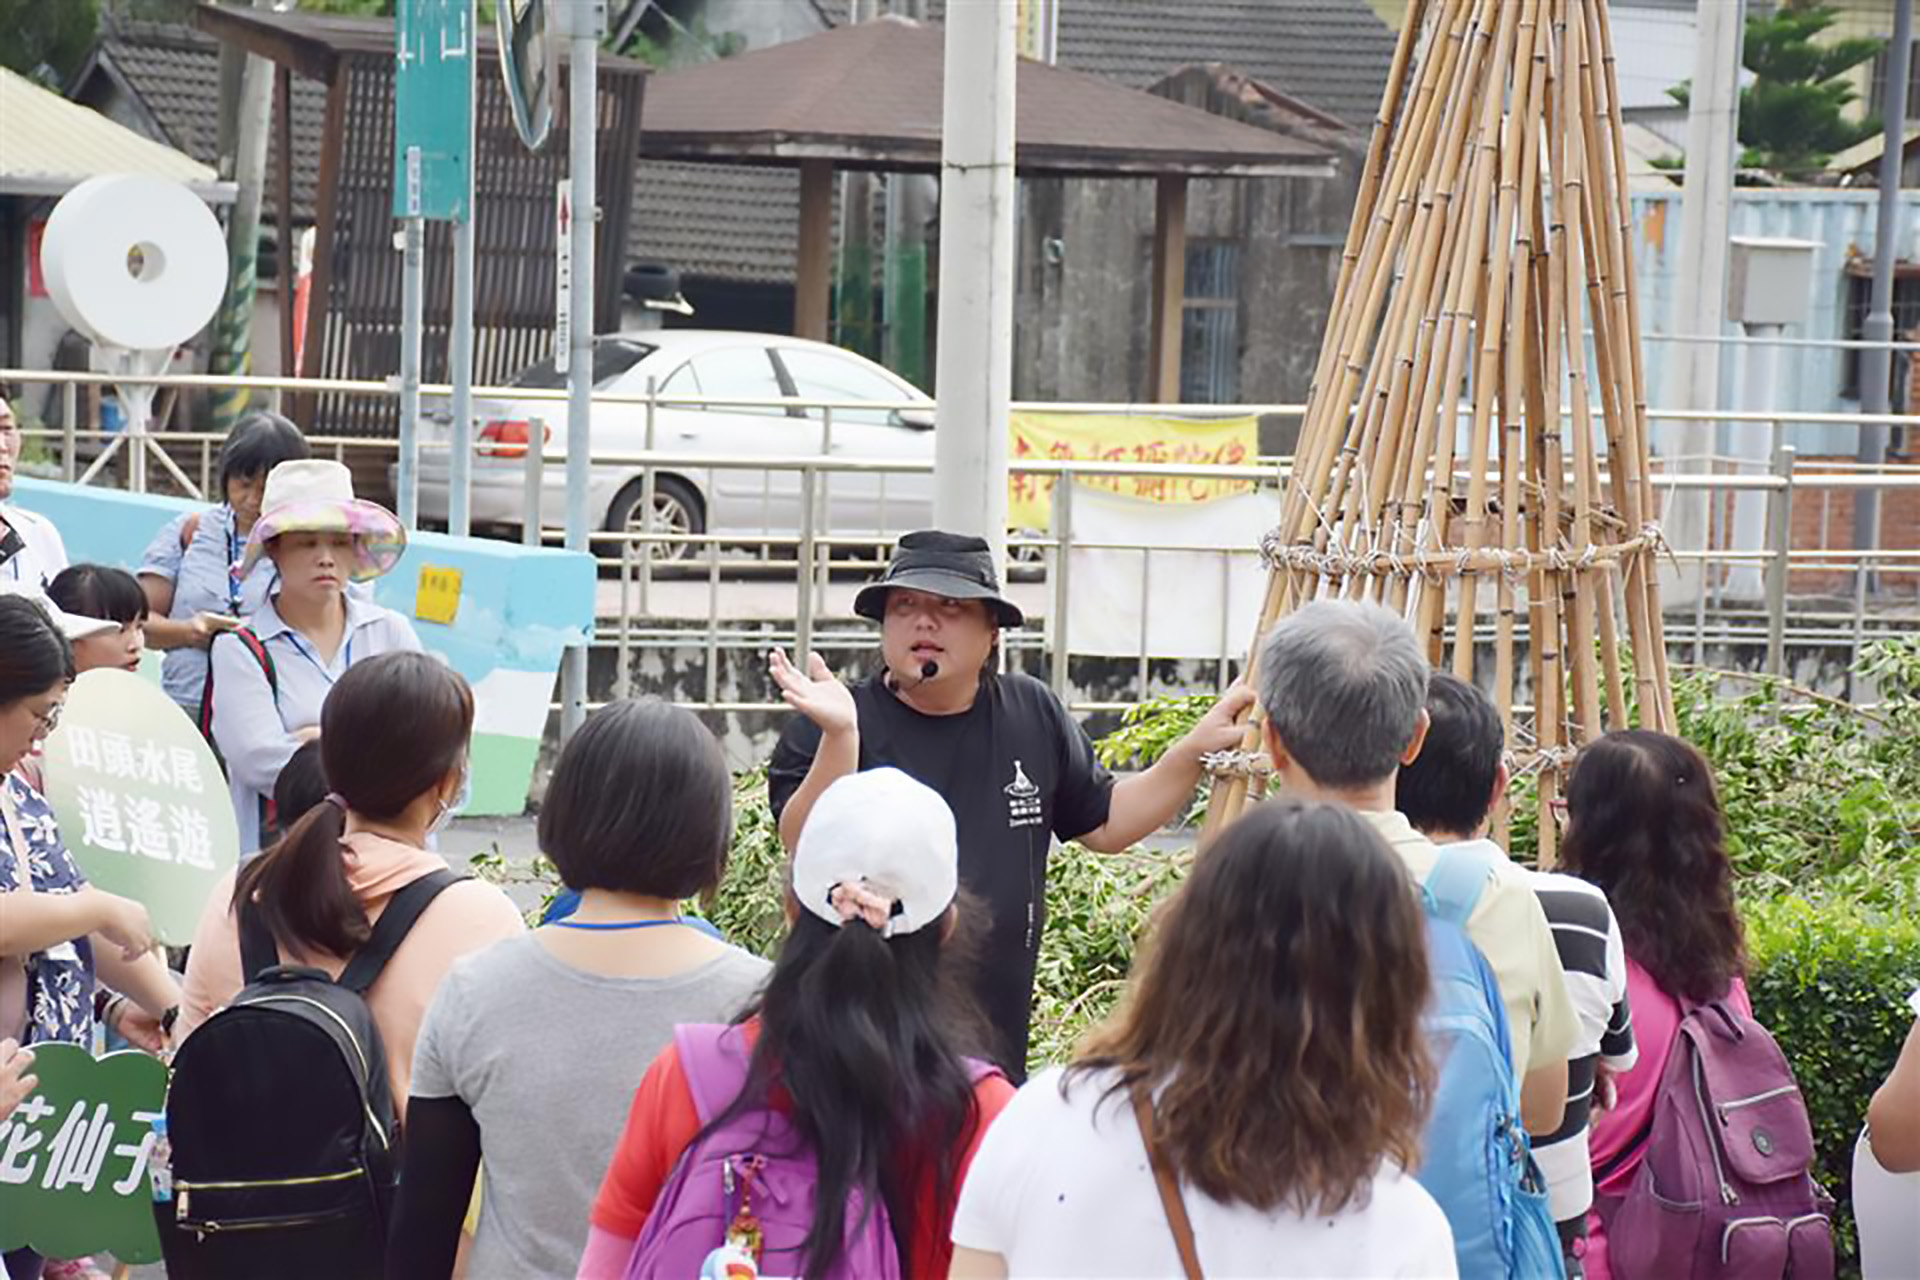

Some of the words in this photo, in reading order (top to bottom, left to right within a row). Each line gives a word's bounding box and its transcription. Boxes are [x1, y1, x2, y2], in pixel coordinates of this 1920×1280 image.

[66, 724, 204, 794] 田頭水尾
[76, 784, 217, 870] 逍遙遊
[0, 1095, 166, 1195] 花仙子
